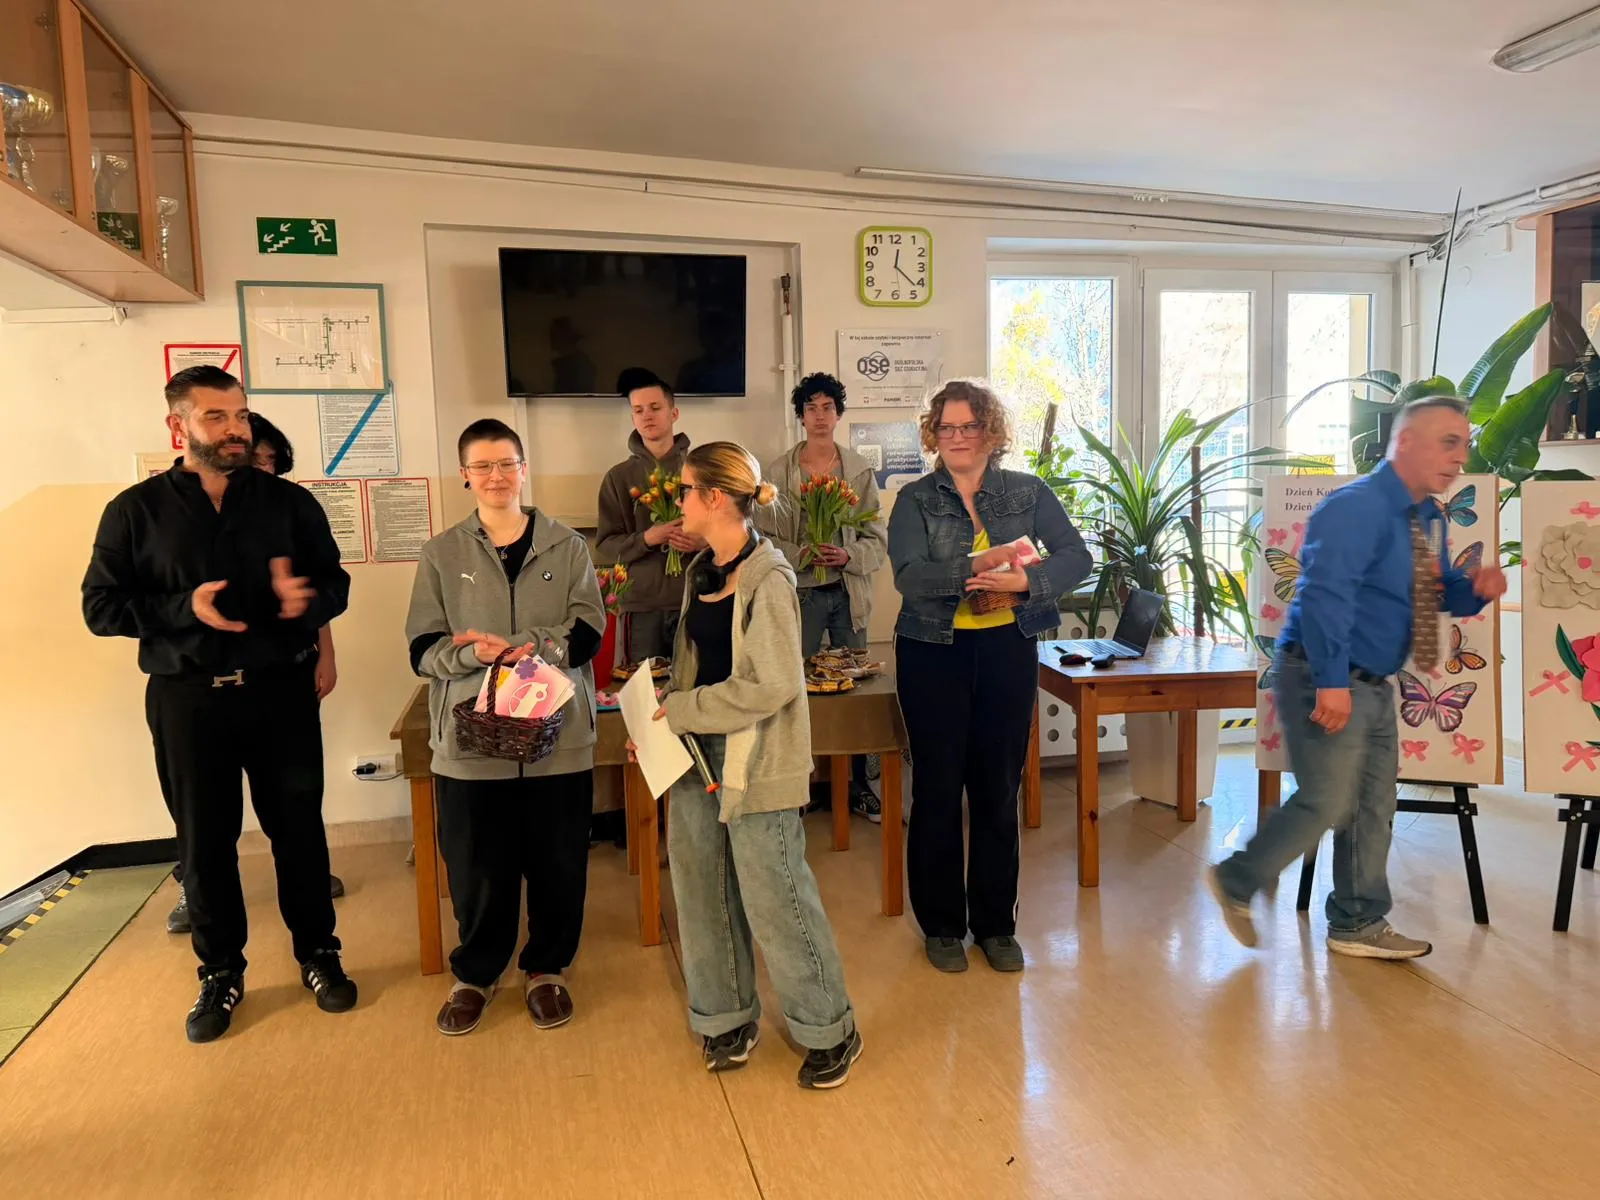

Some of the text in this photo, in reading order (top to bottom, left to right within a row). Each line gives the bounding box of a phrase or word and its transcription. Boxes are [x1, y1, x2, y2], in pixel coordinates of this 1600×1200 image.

[872, 234, 916, 245] 11 12 1
[865, 246, 926, 257] 10 2
[865, 261, 926, 272] 9 3
[866, 276, 925, 287] 8 4
[874, 289, 918, 300] 7 6 5
[1285, 487, 1313, 496] Dzień
[1285, 502, 1312, 511] Dzień
